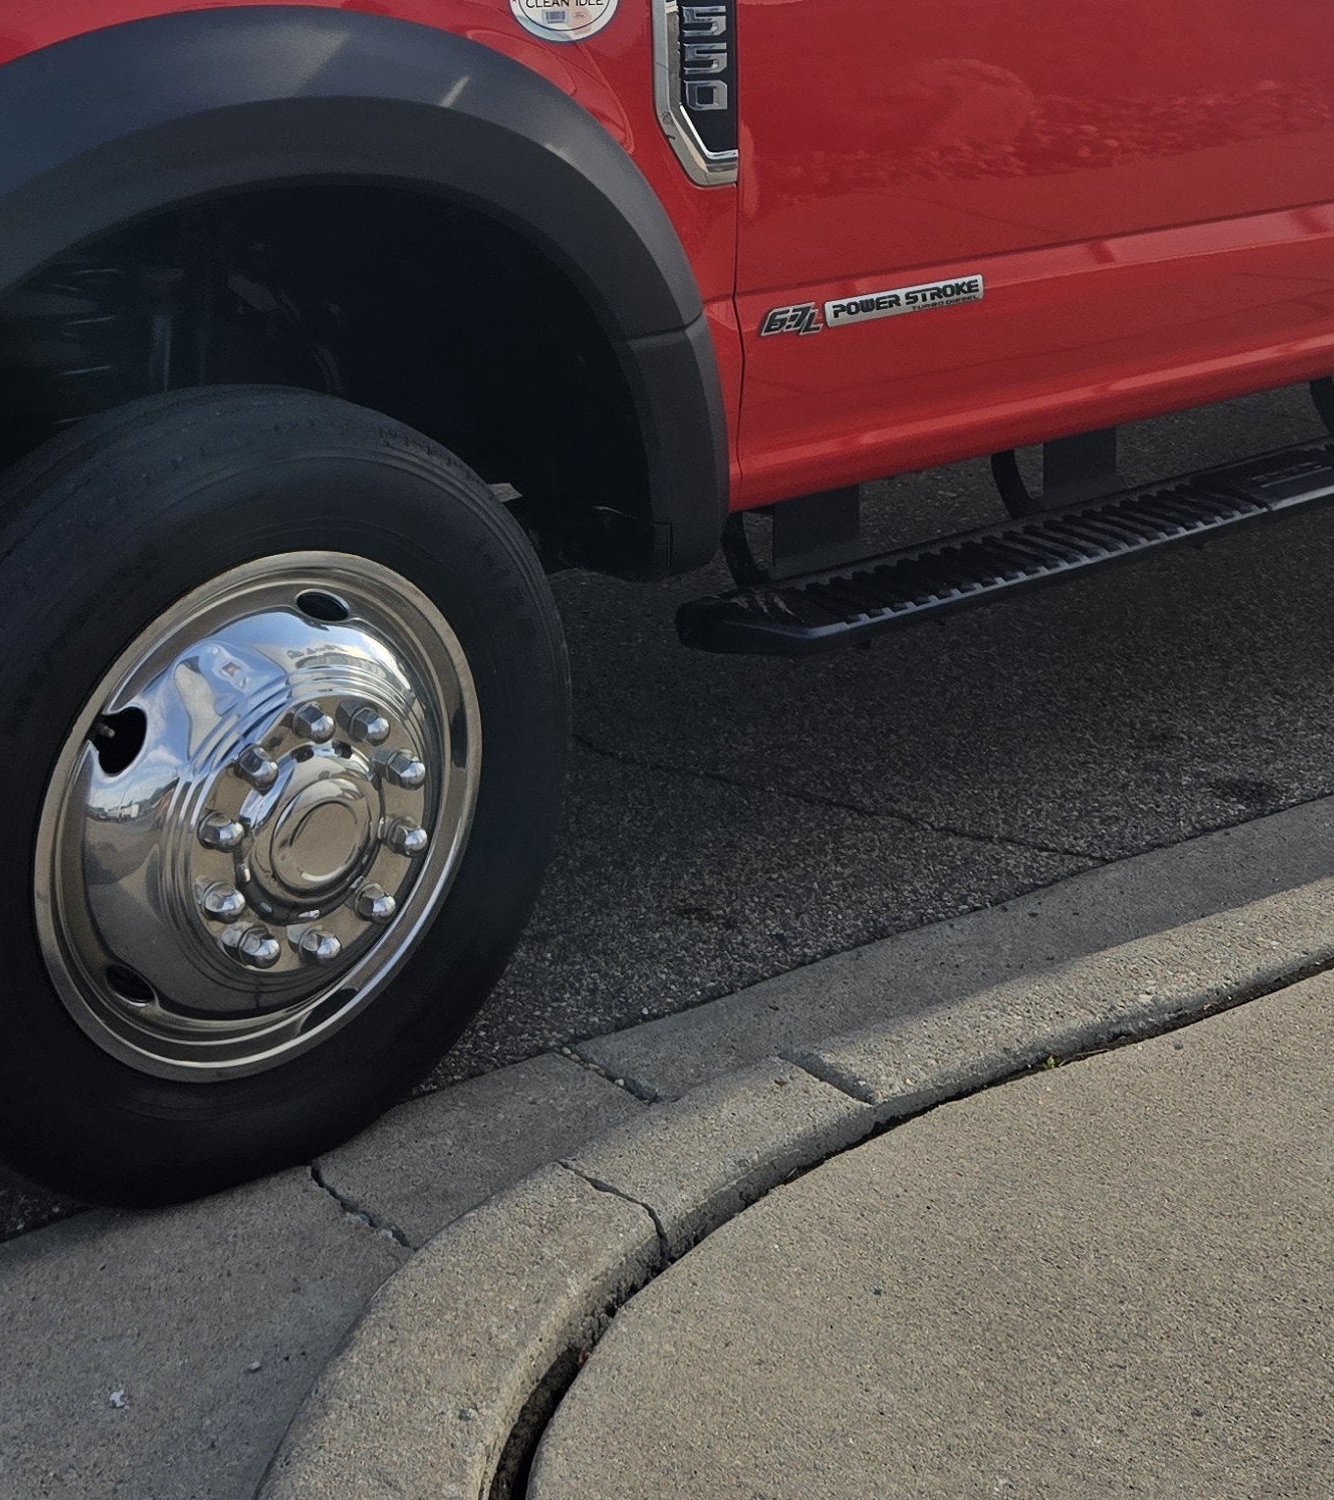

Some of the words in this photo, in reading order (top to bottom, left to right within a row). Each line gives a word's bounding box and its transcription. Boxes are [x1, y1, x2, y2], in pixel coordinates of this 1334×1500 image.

[832, 294, 901, 319] POWER
[904, 278, 980, 306] STROKE
[912, 301, 944, 311] TURBO
[944, 294, 979, 306] DIESEL
